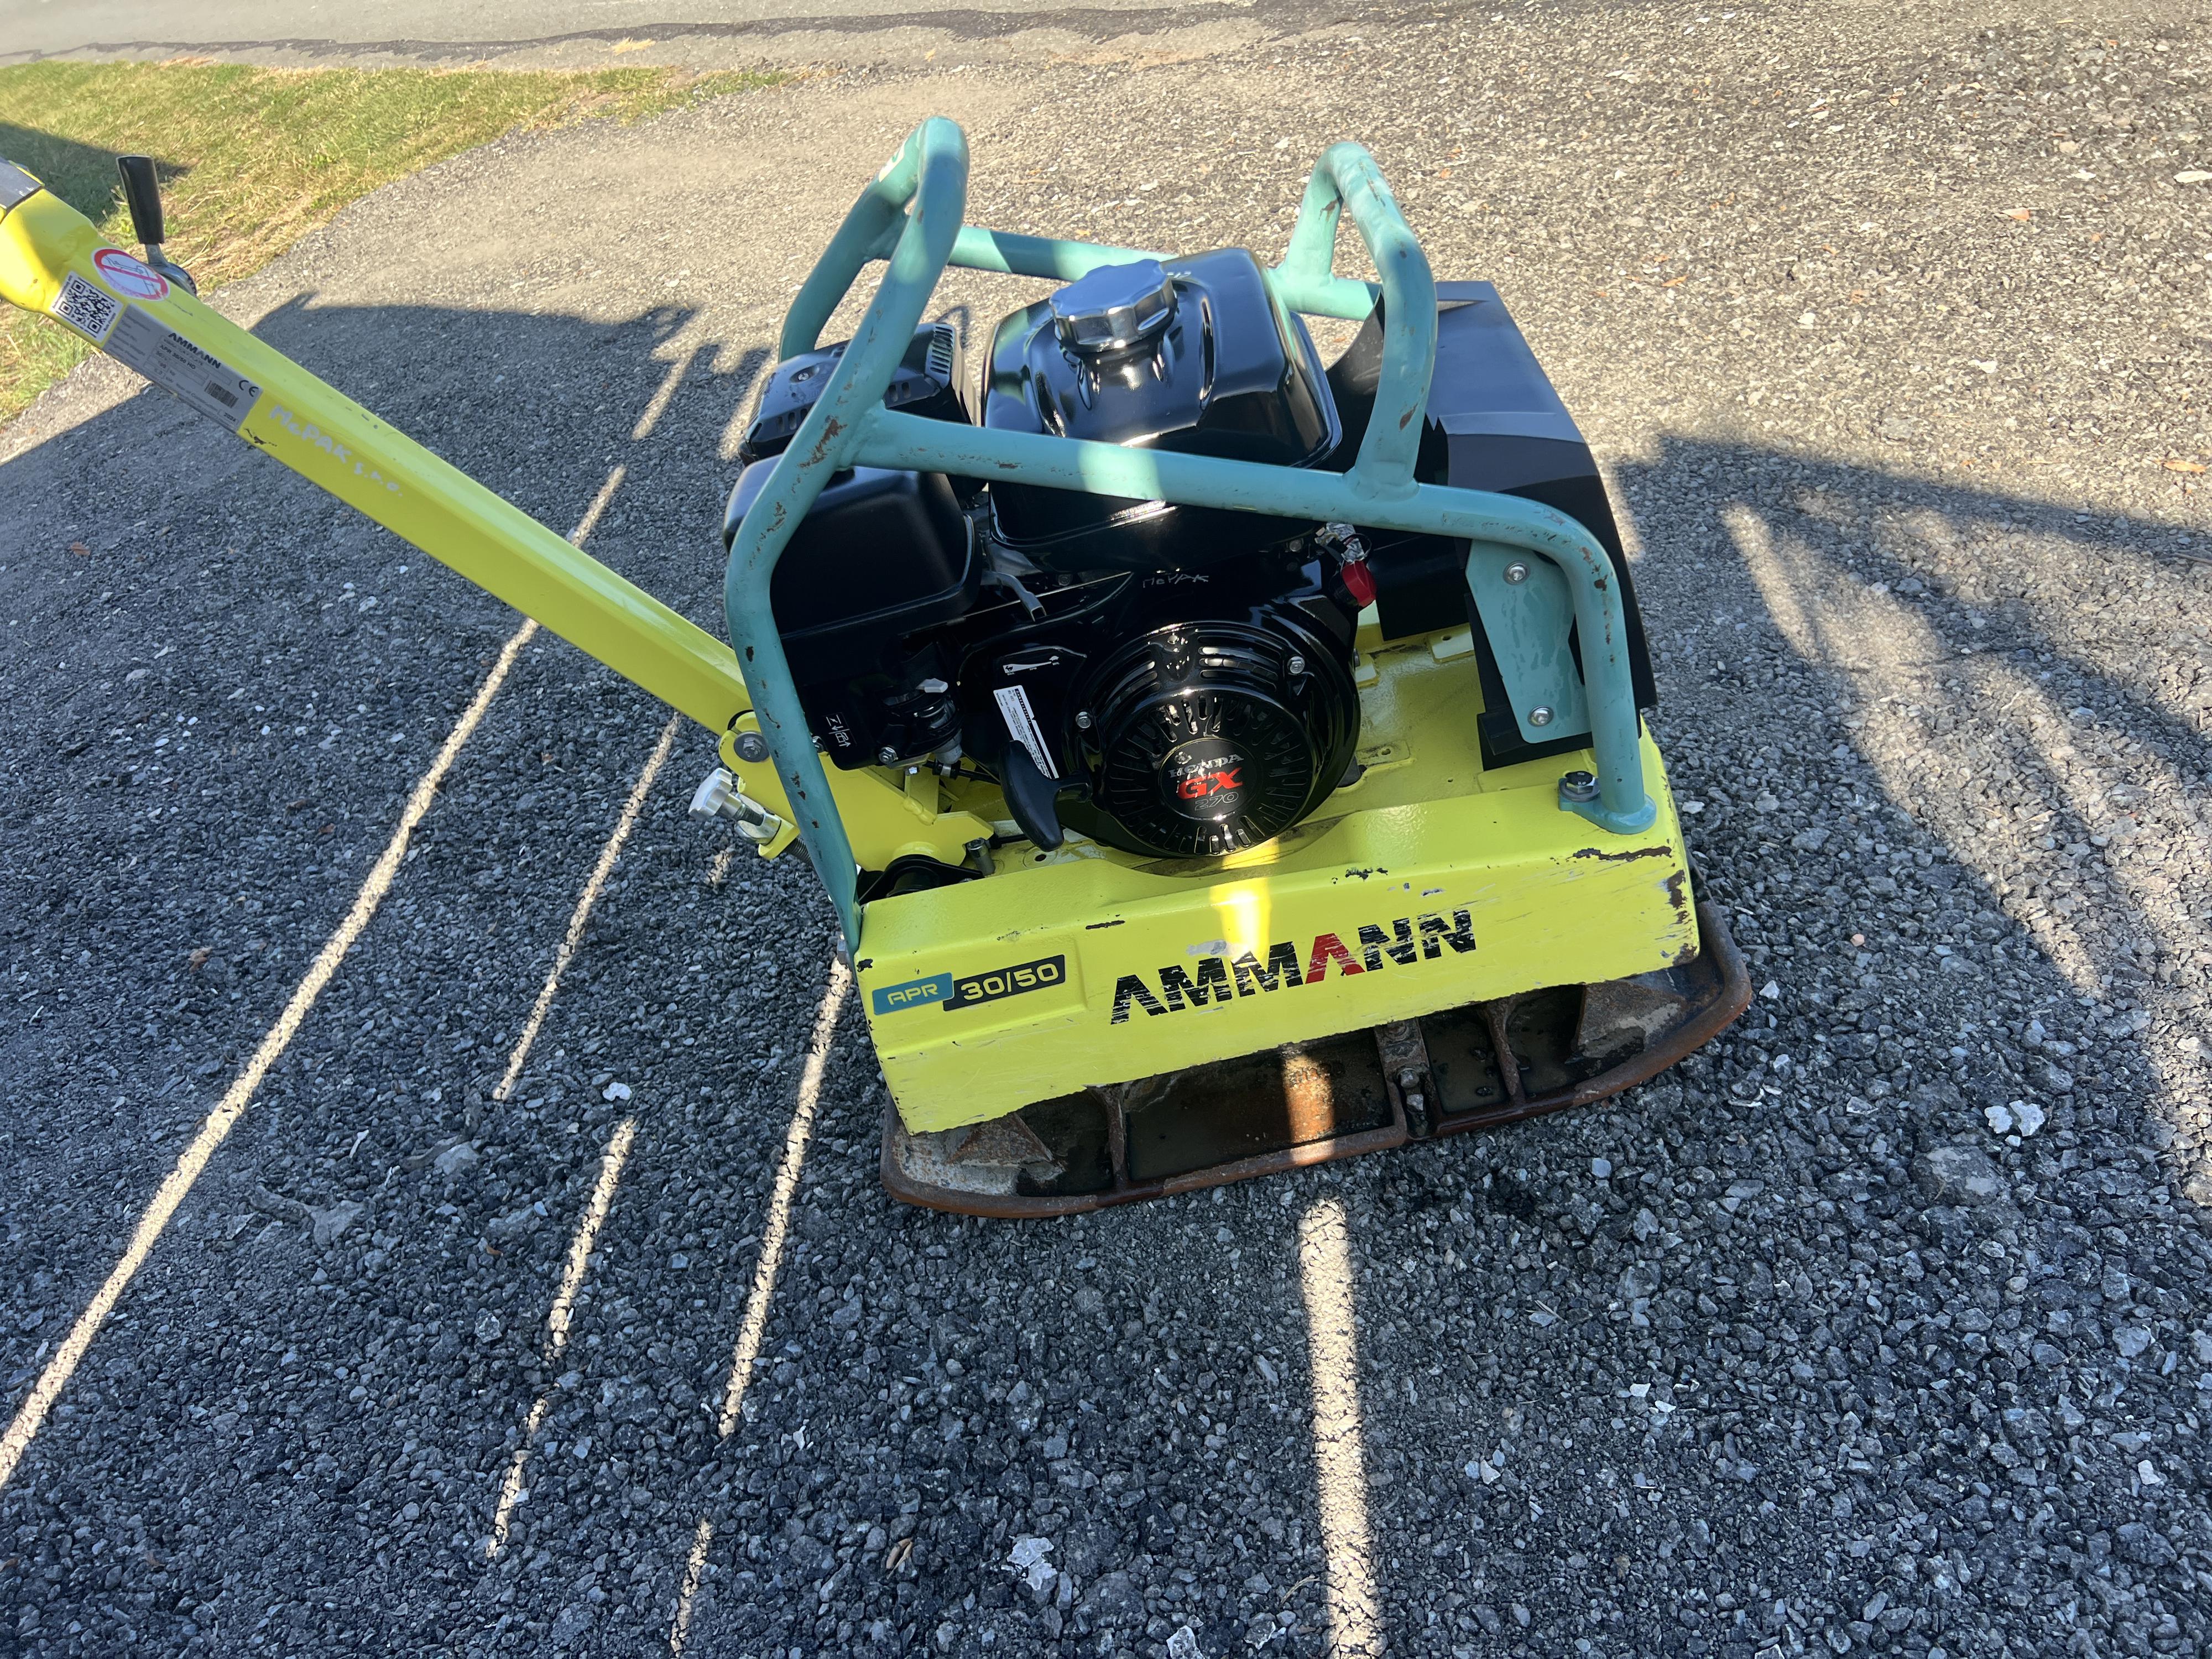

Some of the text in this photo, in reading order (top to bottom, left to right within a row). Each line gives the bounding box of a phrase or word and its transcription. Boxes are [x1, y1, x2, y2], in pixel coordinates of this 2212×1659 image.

[168, 332, 221, 369] AMMANN
[1168, 754, 1244, 778] HONDA
[1177, 767, 1243, 800] GX
[1194, 791, 1239, 811] 270
[887, 963, 1059, 1006] APR 30/50
[1110, 909, 1477, 1025] AMMANN
